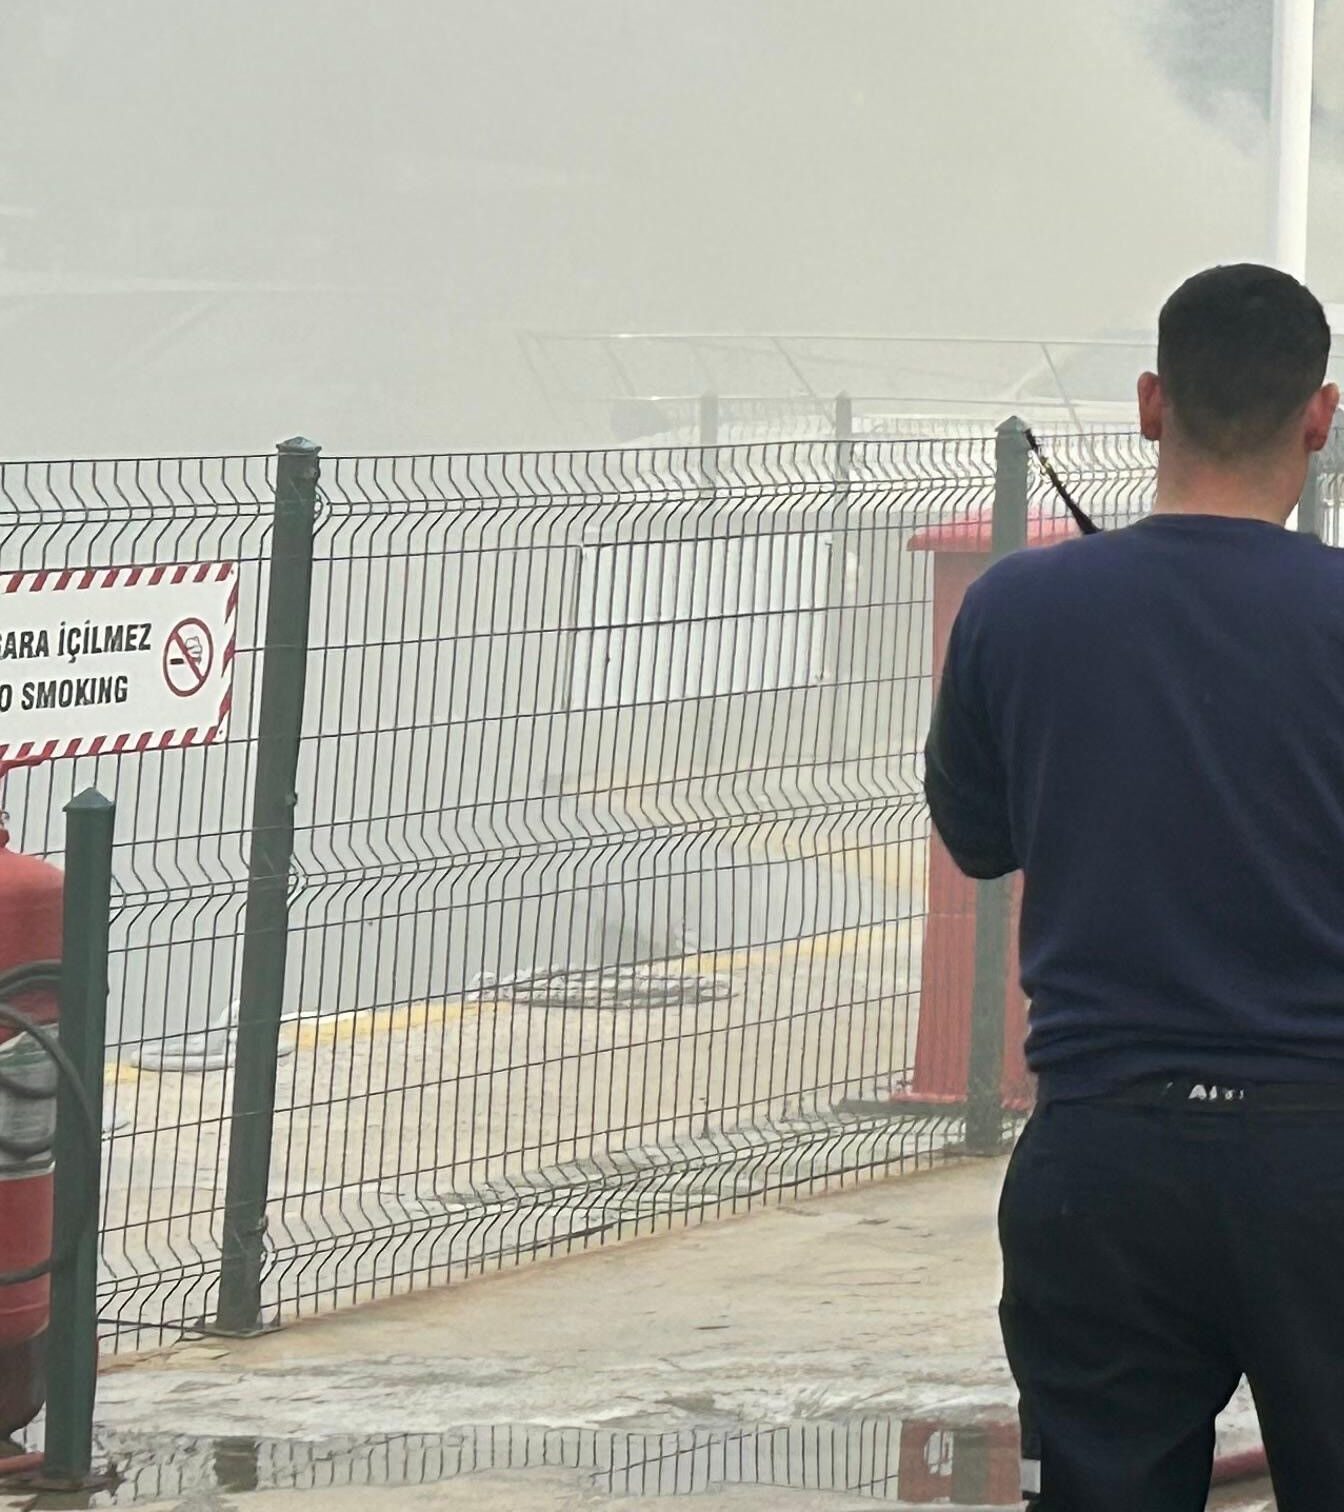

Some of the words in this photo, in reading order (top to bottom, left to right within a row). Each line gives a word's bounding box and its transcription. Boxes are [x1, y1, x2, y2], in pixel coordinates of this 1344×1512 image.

[0, 629, 50, 660] ARA
[57, 619, 153, 664] İÇİLMEZ
[21, 675, 129, 711] SMOKING
